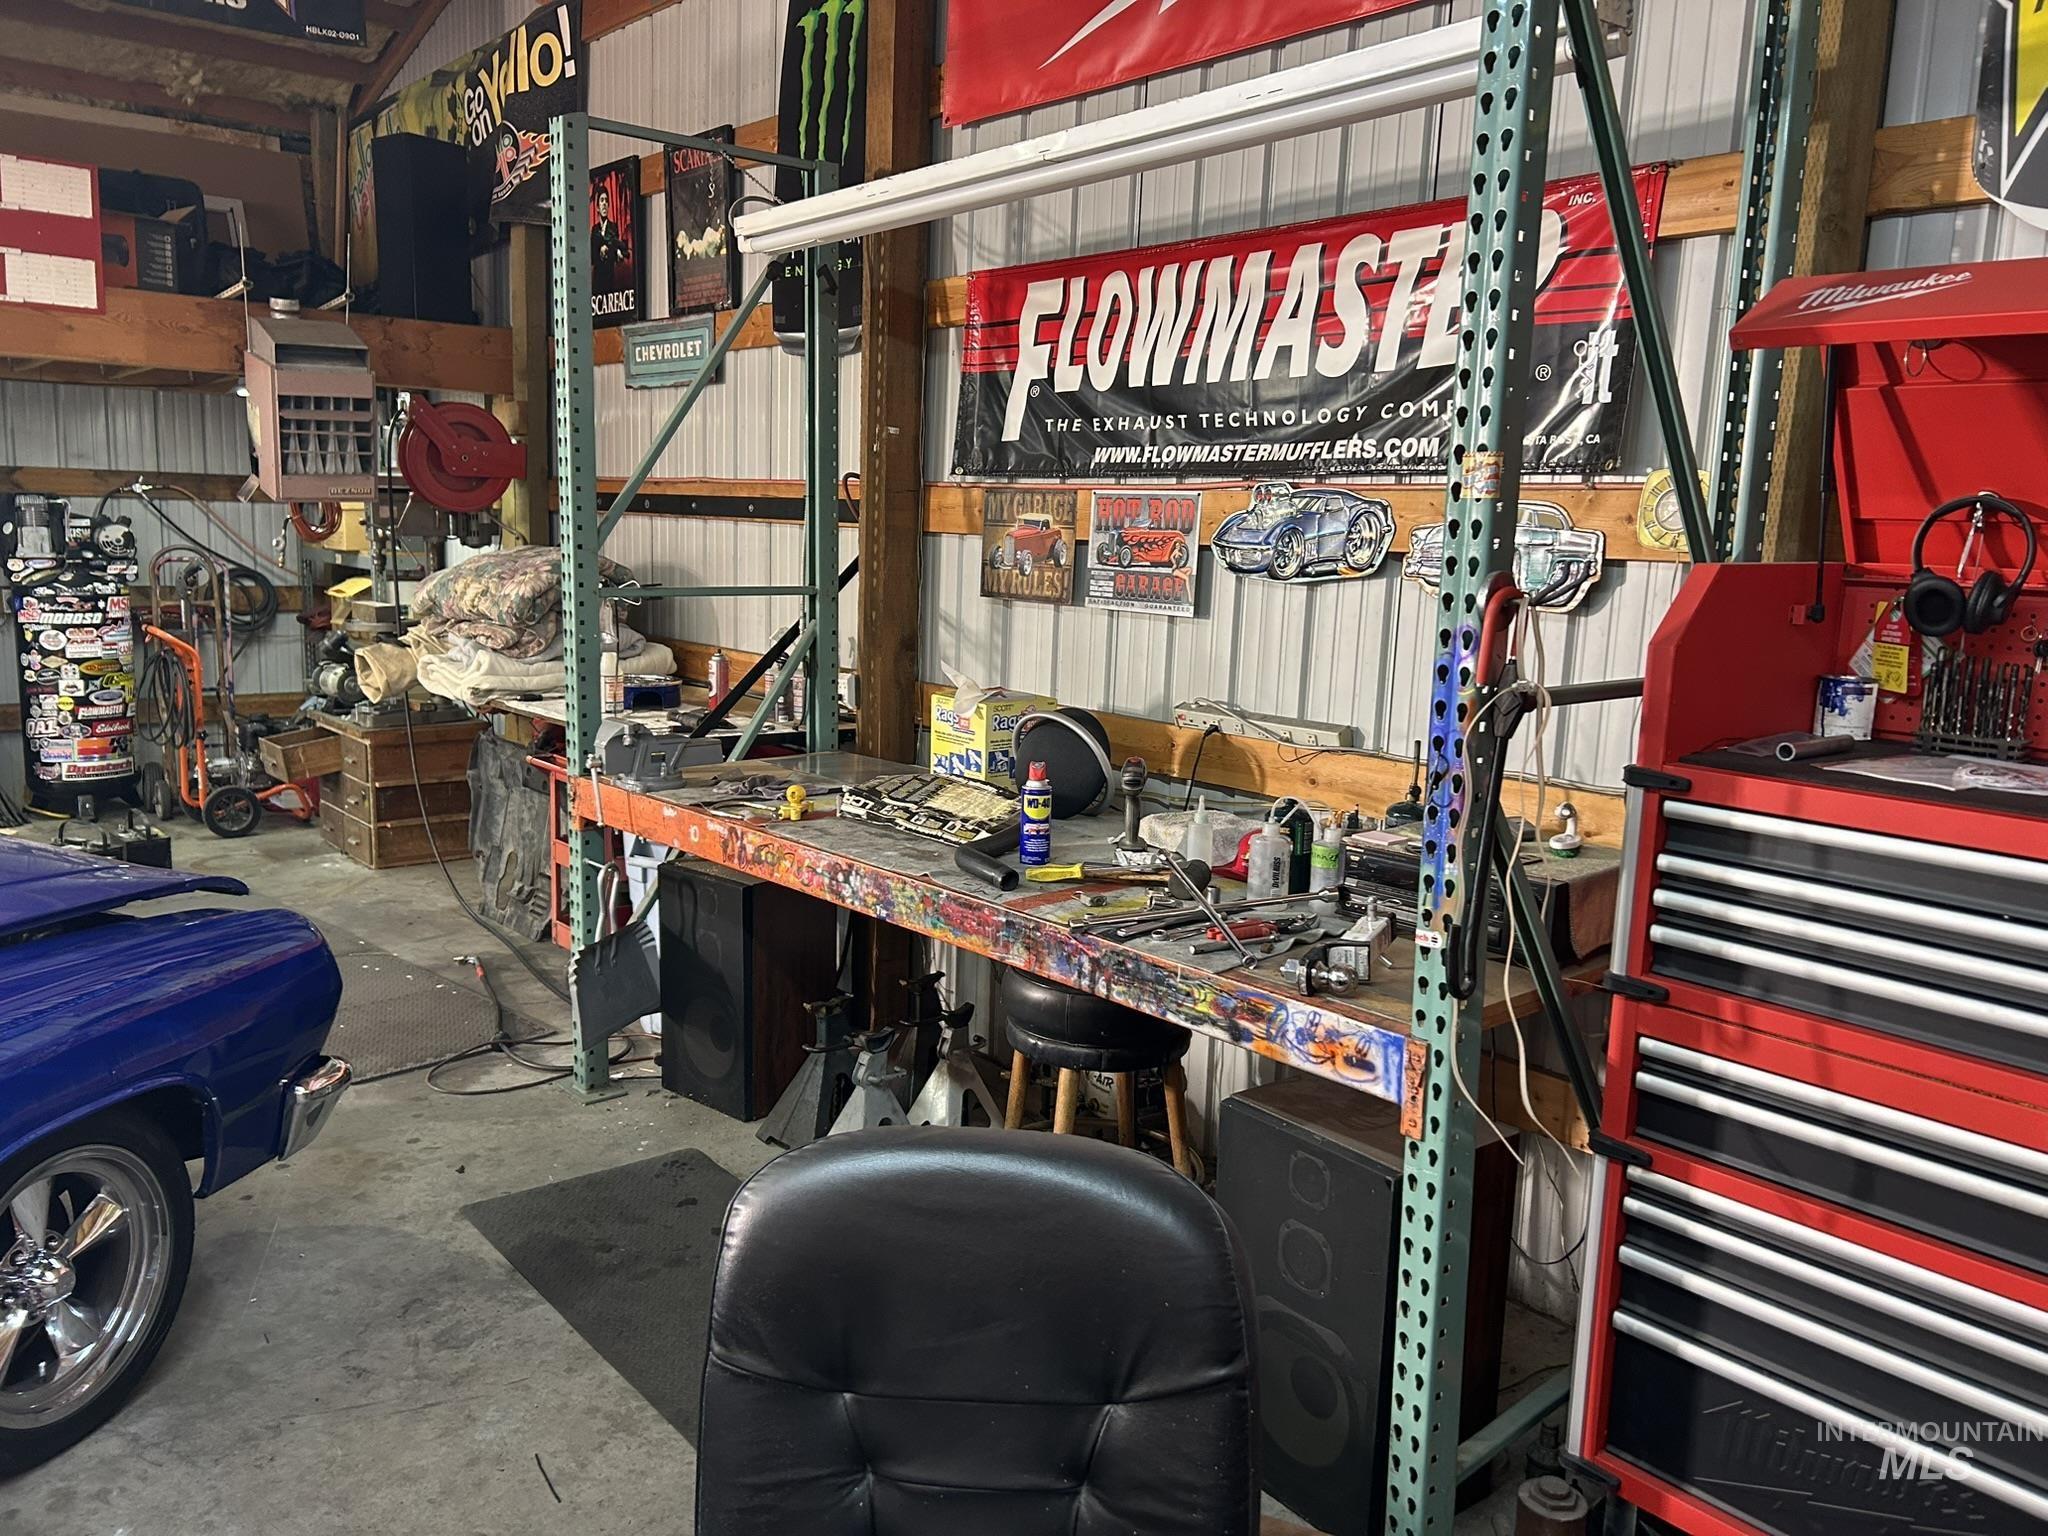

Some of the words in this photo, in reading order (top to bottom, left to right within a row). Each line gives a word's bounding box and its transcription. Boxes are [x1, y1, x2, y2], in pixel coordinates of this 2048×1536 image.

[464, 86, 485, 125] Go
[472, 109, 493, 147] on
[1568, 191, 1597, 206] INC.
[785, 258, 852, 277] ENGY
[591, 289, 635, 316] SCARFACE
[1798, 271, 1973, 309] Milwaukee
[635, 339, 702, 363] CHEVROLET
[1045, 418, 1082, 432] THE
[1093, 414, 1188, 432] EXHAUST
[1199, 405, 1367, 429] TECHNOLOGY
[1094, 437, 1440, 463] WWW.FLOWMASTERMUFFLERS.COM
[1585, 433, 1601, 444] CA
[987, 493, 1010, 521] MY
[1013, 491, 1074, 522] GARAGE
[1096, 497, 1142, 531] HOT
[1149, 498, 1196, 533] ROD
[984, 570, 1005, 594] MY
[1006, 567, 1068, 597] RULES!
[1114, 572, 1186, 601] GARAGE
[40, 612, 103, 624] MOROSO
[936, 706, 959, 727] Rags
